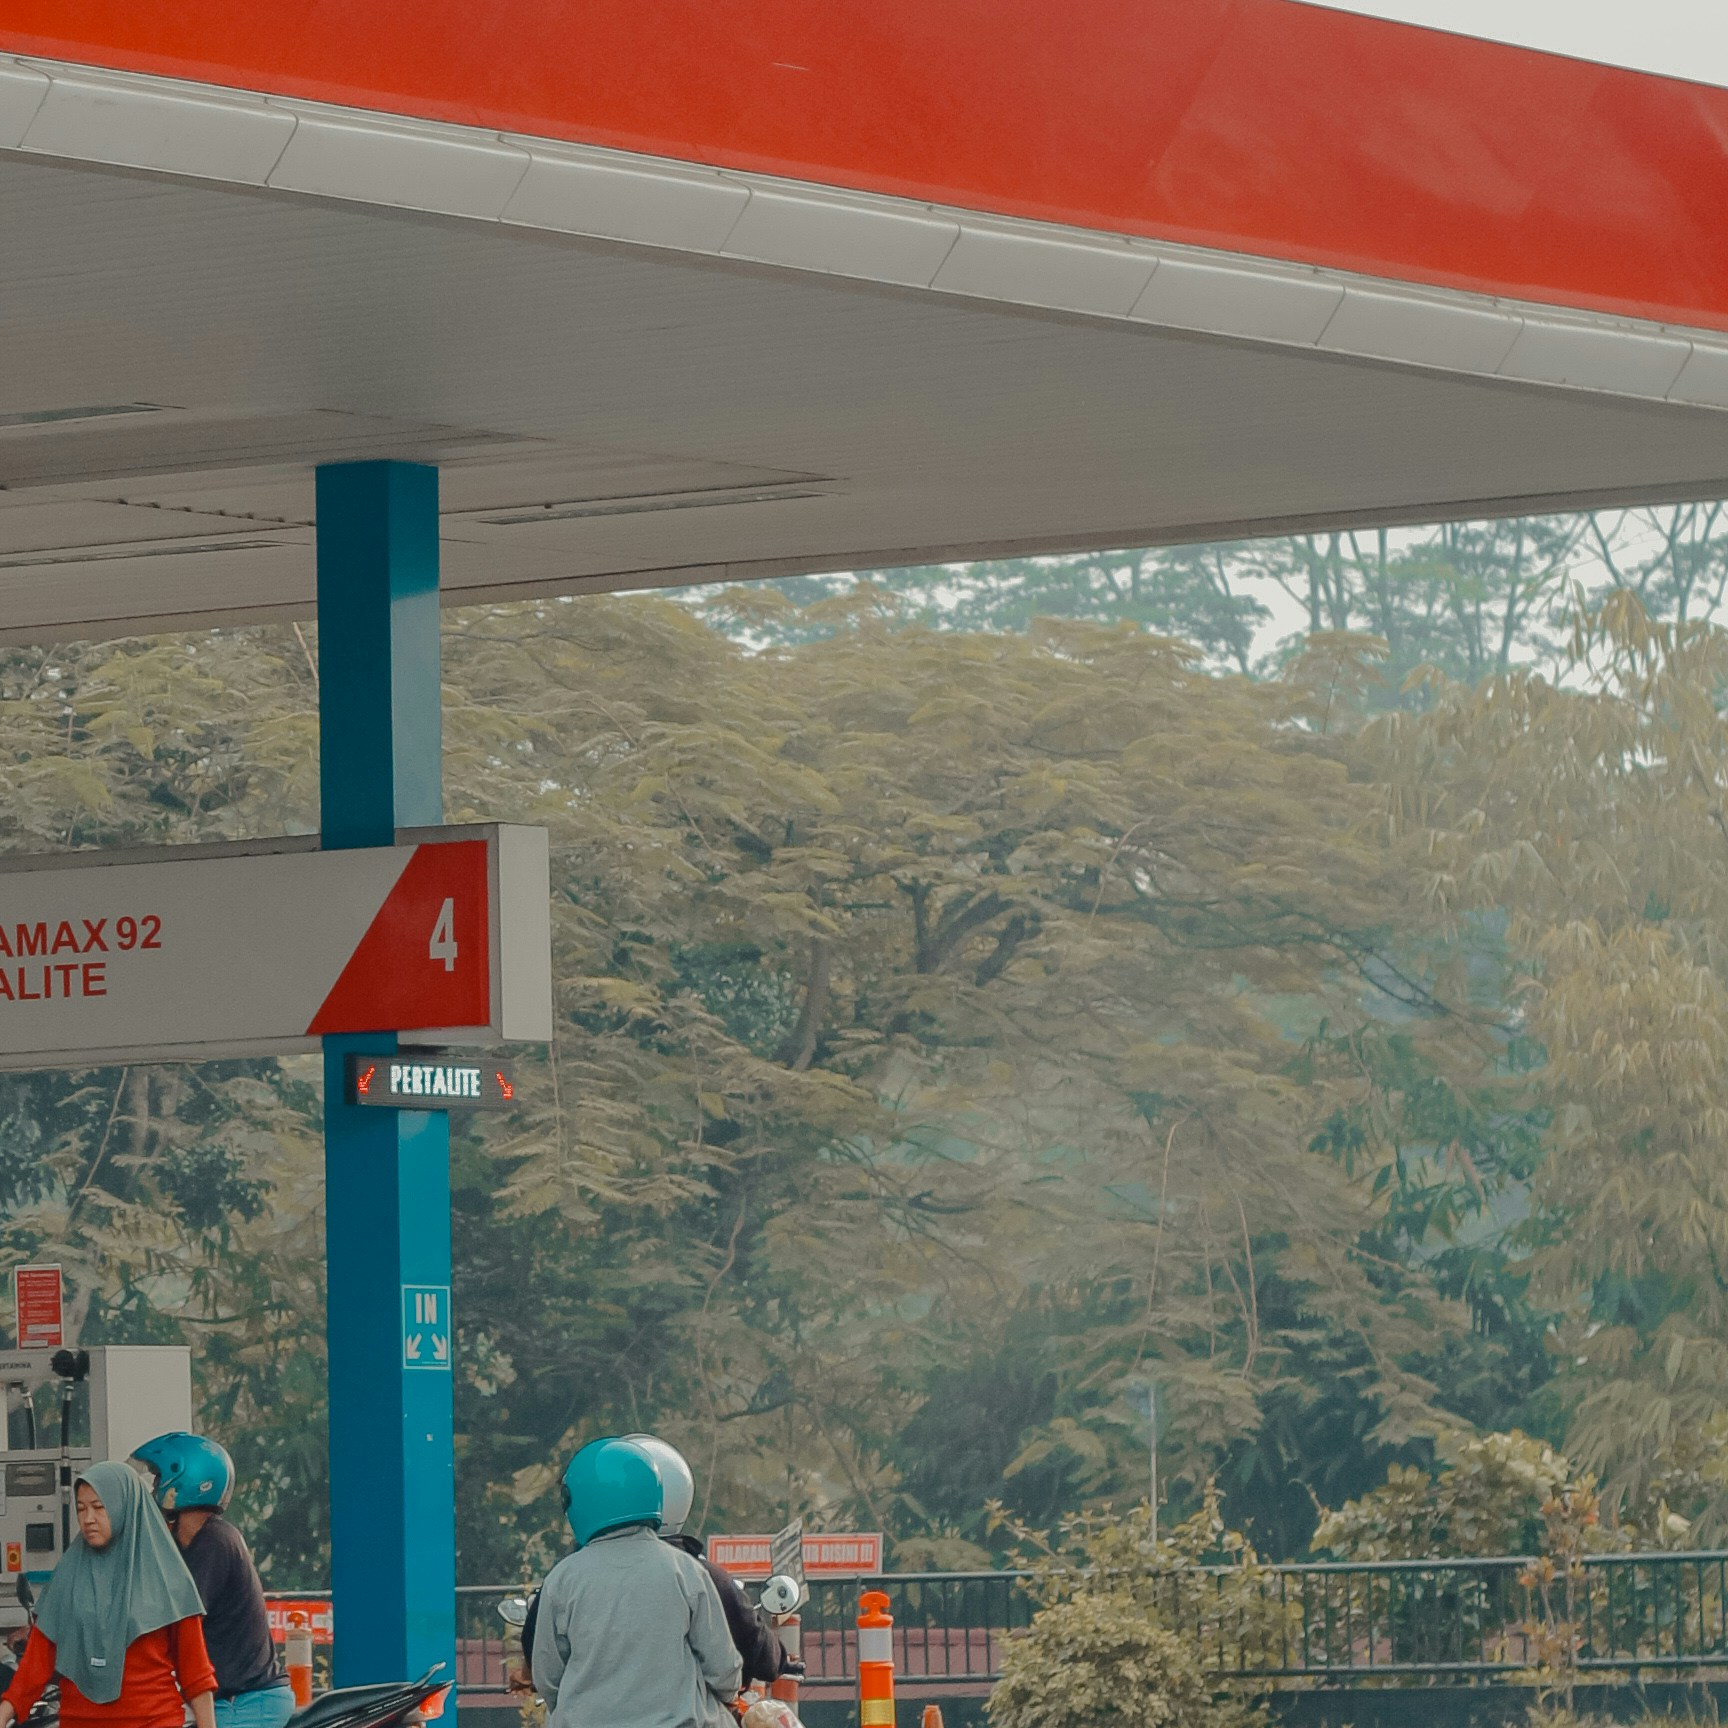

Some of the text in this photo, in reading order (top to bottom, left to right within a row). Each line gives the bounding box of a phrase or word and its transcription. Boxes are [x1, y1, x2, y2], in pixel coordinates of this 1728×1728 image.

[116, 915, 162, 951] 92
[429, 897, 458, 972] 4
[390, 1065, 481, 1097] PERTALITE
[415, 1293, 437, 1324] IN
